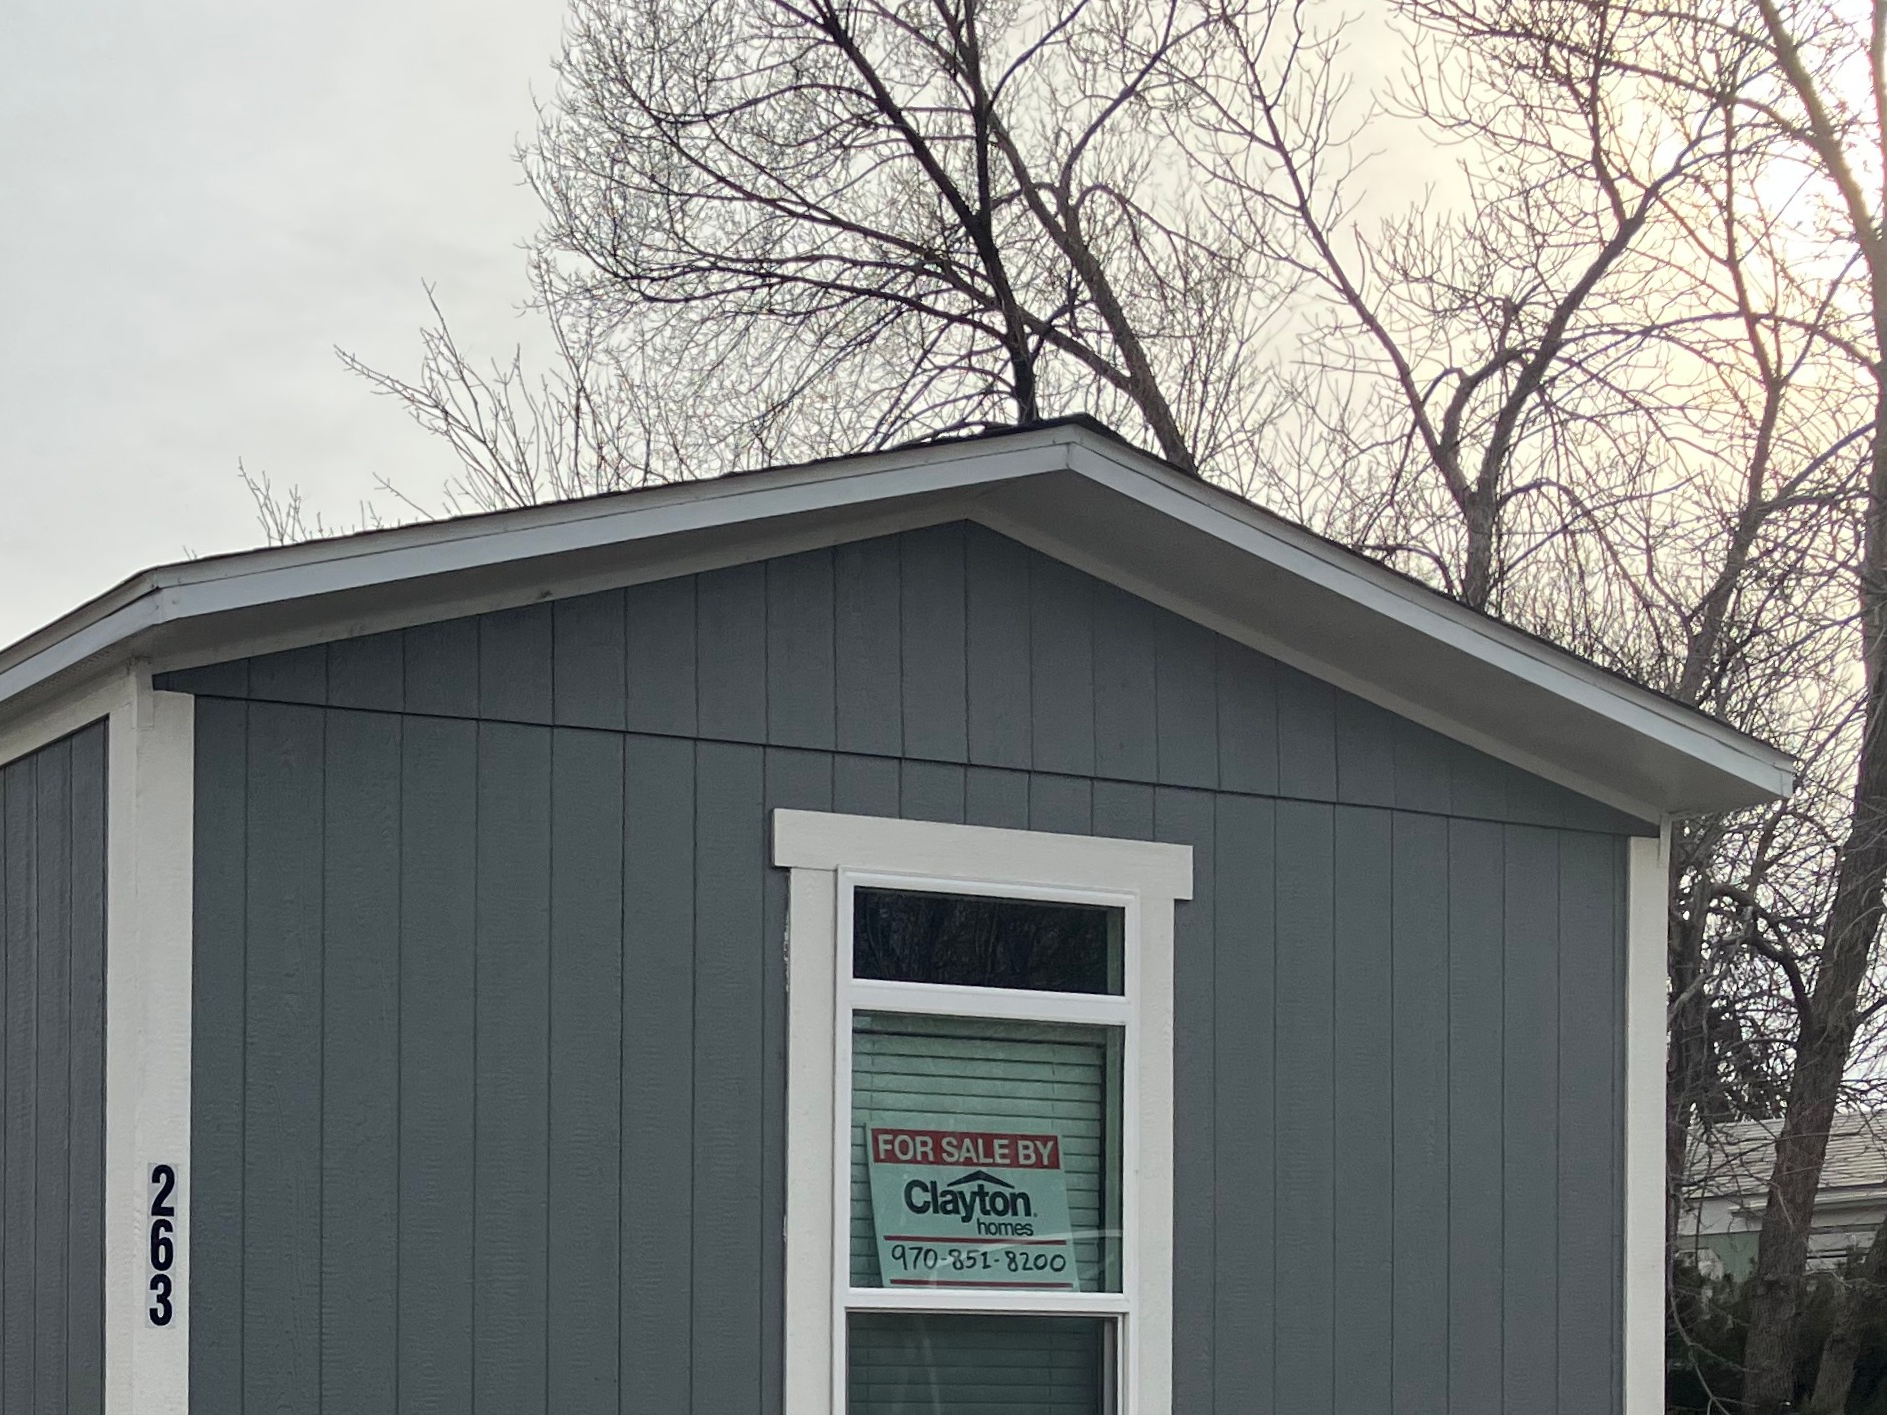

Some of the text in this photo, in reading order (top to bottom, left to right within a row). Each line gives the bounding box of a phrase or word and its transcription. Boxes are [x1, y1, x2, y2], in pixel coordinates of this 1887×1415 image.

[877, 1134, 1054, 1166] FOR SALE BY
[903, 1179, 1032, 1223] Clayton
[977, 1218, 1034, 1237] homes
[149, 1164, 175, 1326] 263
[891, 1244, 1067, 1272] 970-851-8200
